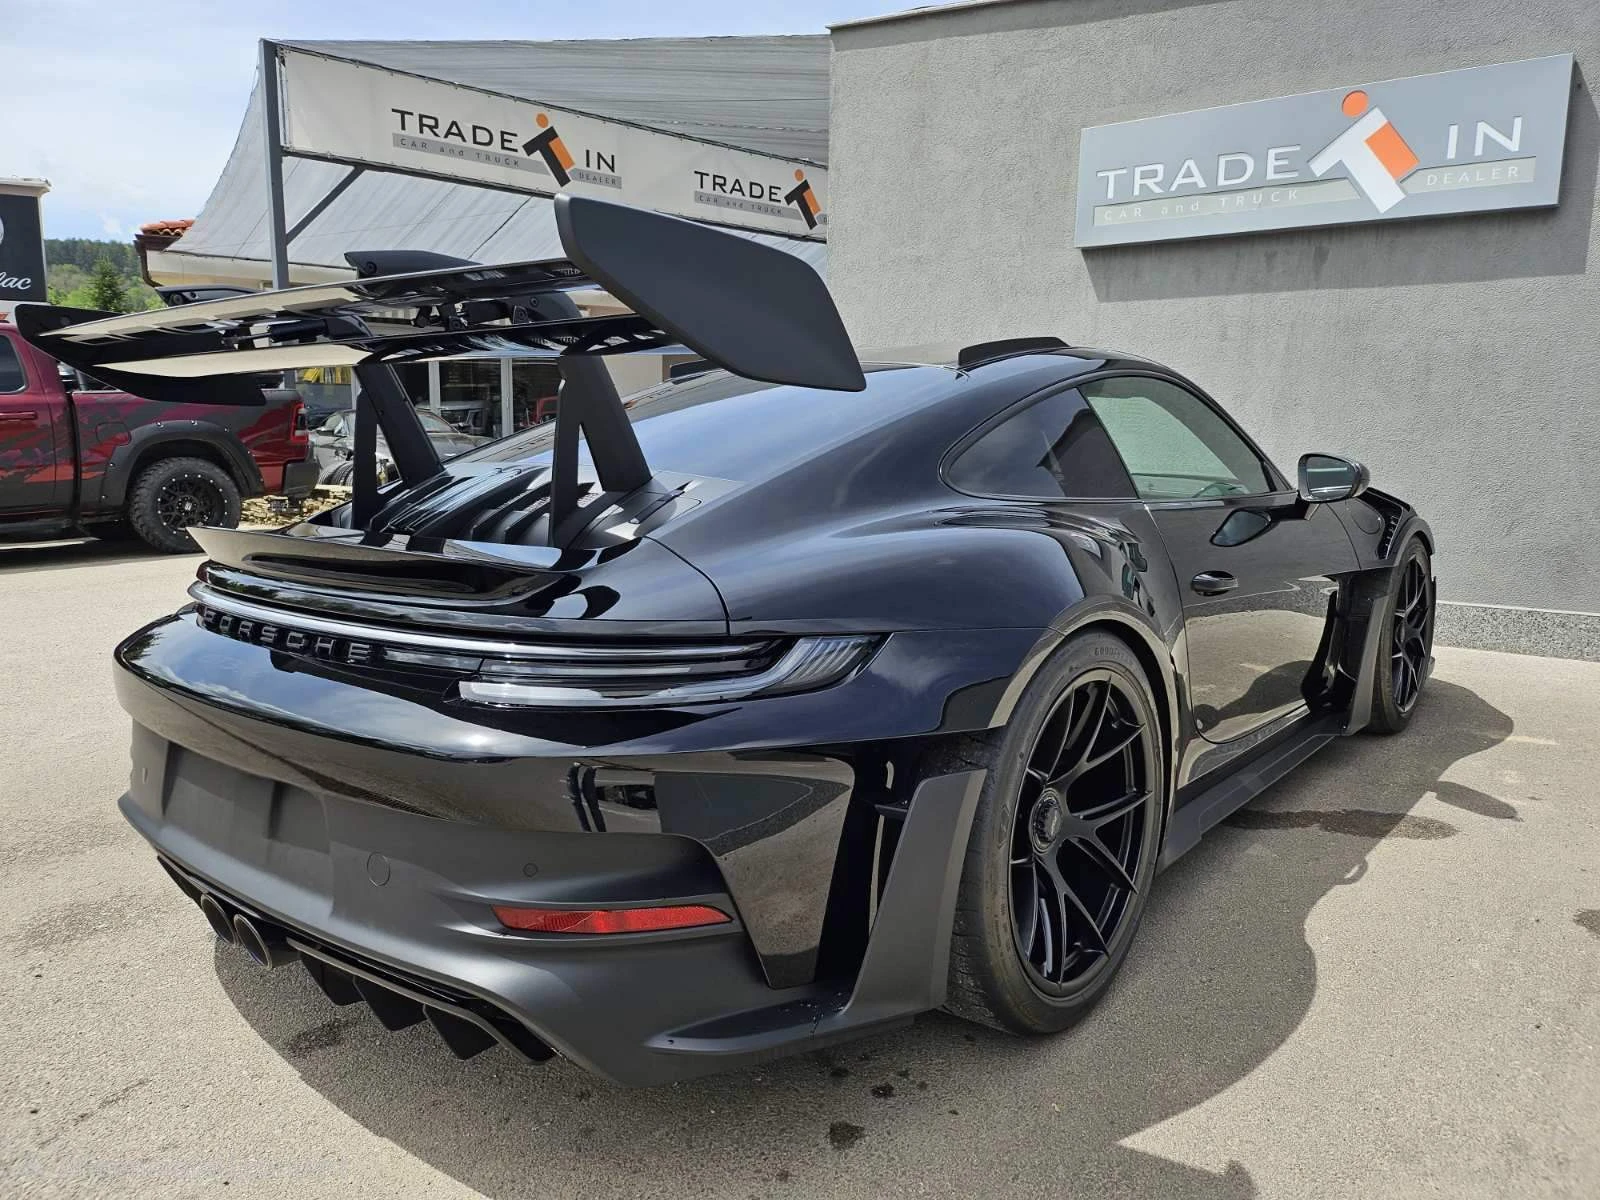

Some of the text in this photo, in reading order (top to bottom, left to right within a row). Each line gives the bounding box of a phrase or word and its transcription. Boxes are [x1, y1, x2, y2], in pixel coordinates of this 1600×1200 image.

[391, 107, 519, 153] TRADE
[584, 148, 617, 173] IN
[400, 138, 428, 150] CAR
[475, 151, 521, 167] TRUCK
[578, 171, 618, 186] DEALER
[1096, 144, 1303, 201] TRADE
[1445, 115, 1524, 161] IN
[693, 170, 782, 203] TRADE
[1103, 164, 1522, 221] CAR and TRUCK DEALER
[203, 605, 371, 664] PORSCHE
